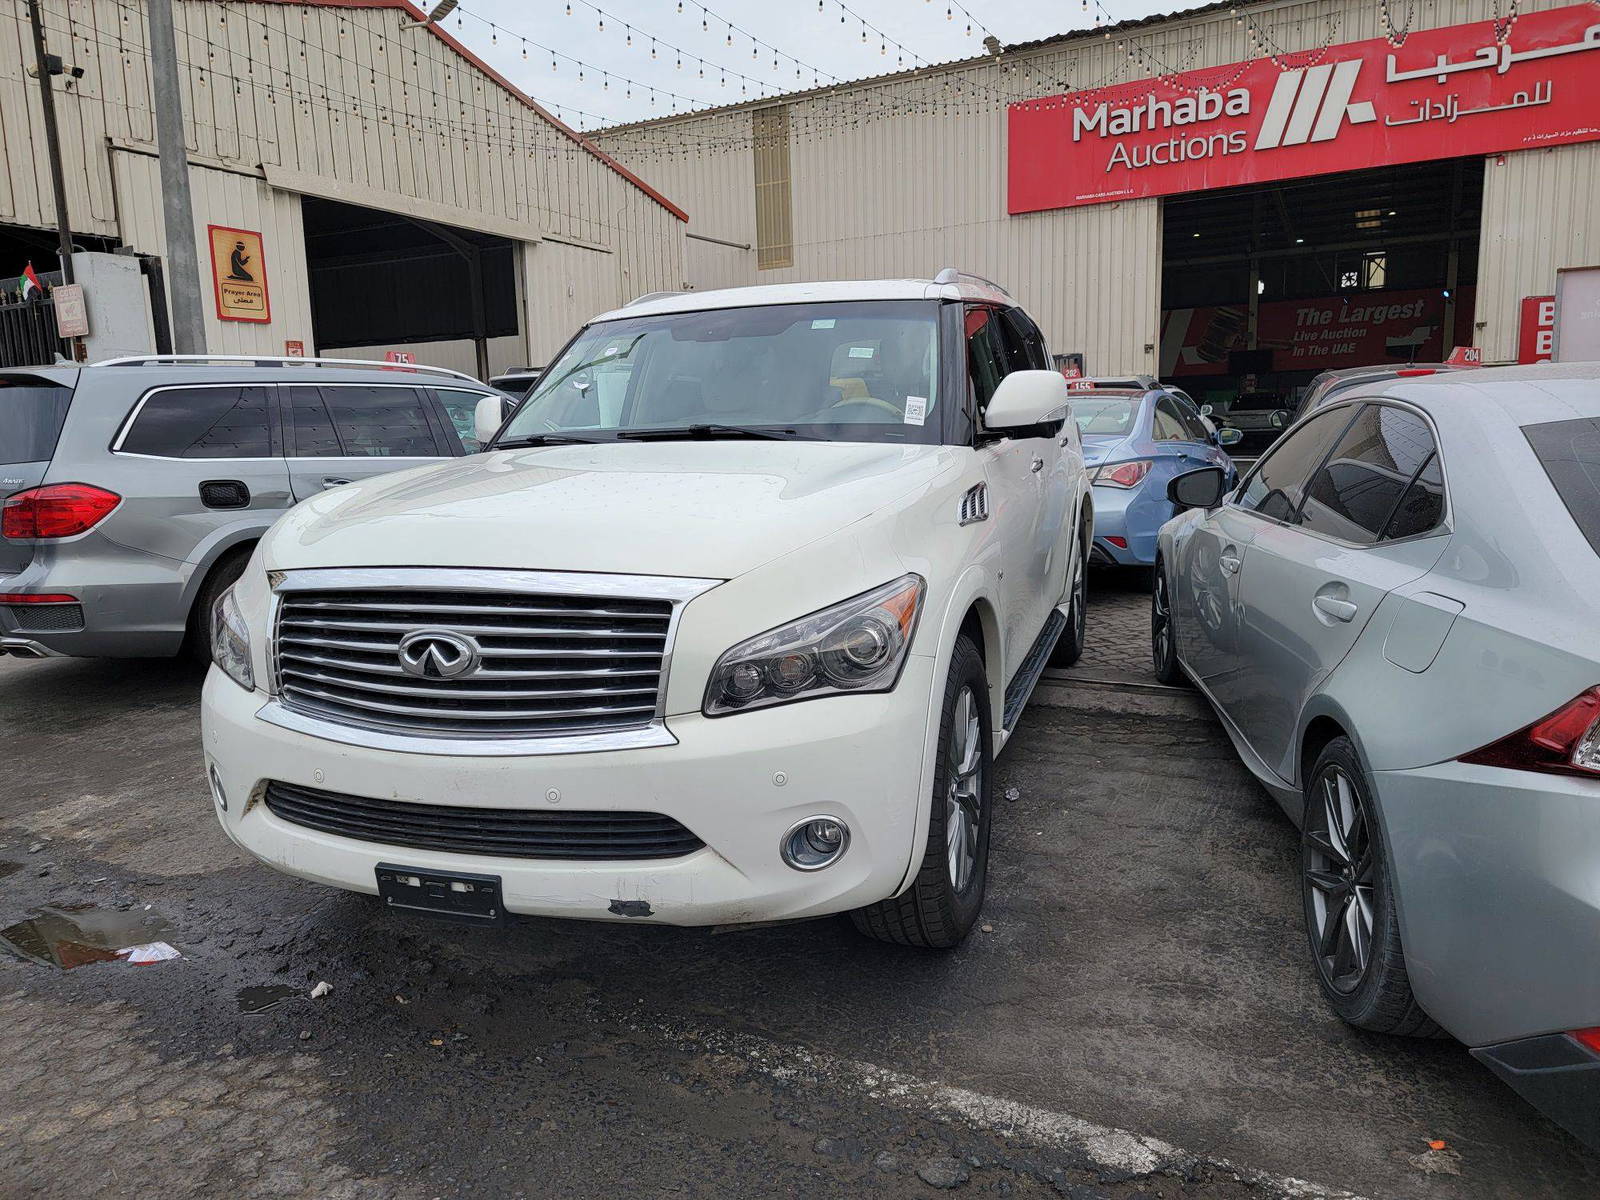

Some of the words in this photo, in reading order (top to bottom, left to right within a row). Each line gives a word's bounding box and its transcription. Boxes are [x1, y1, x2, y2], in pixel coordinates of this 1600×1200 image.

[1385, 80, 1553, 126] للمزادات
[1072, 86, 1250, 142] Marhaba
[1105, 130, 1247, 173] Auctions
[223, 288, 245, 296] Prayer
[1296, 307, 1332, 326] The
[1339, 299, 1425, 325] Largest
[1294, 330, 1318, 341] Live
[1320, 327, 1367, 340] Auction
[1292, 346, 1305, 357] In
[1308, 345, 1329, 356] The
[1332, 343, 1357, 355] UAE
[1464, 349, 1479, 361] 204
[395, 353, 409, 363] 75
